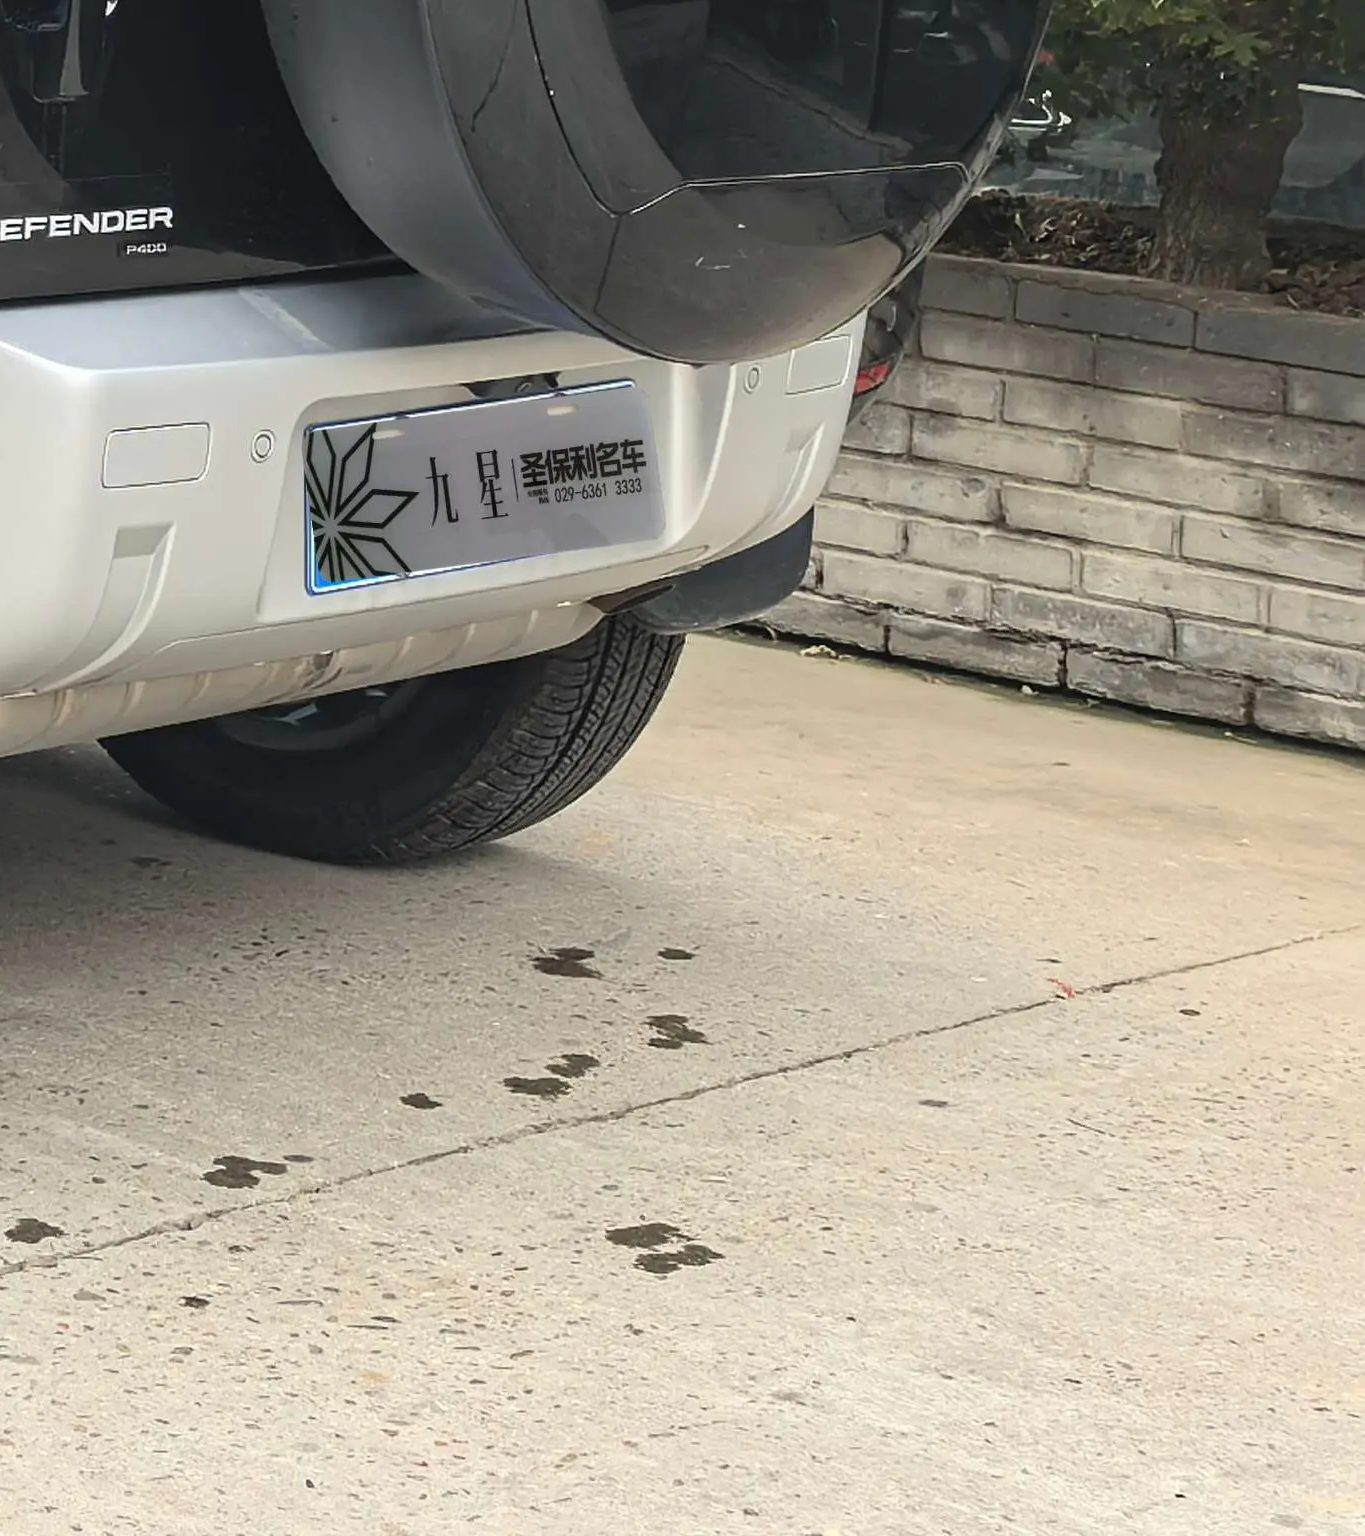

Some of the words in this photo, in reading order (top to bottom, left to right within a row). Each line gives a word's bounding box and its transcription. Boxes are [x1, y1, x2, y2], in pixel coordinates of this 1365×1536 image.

[520, 440, 646, 487] 圣保利名车
[554, 482, 607, 504] 029-6361
[614, 477, 643, 496] 3333
